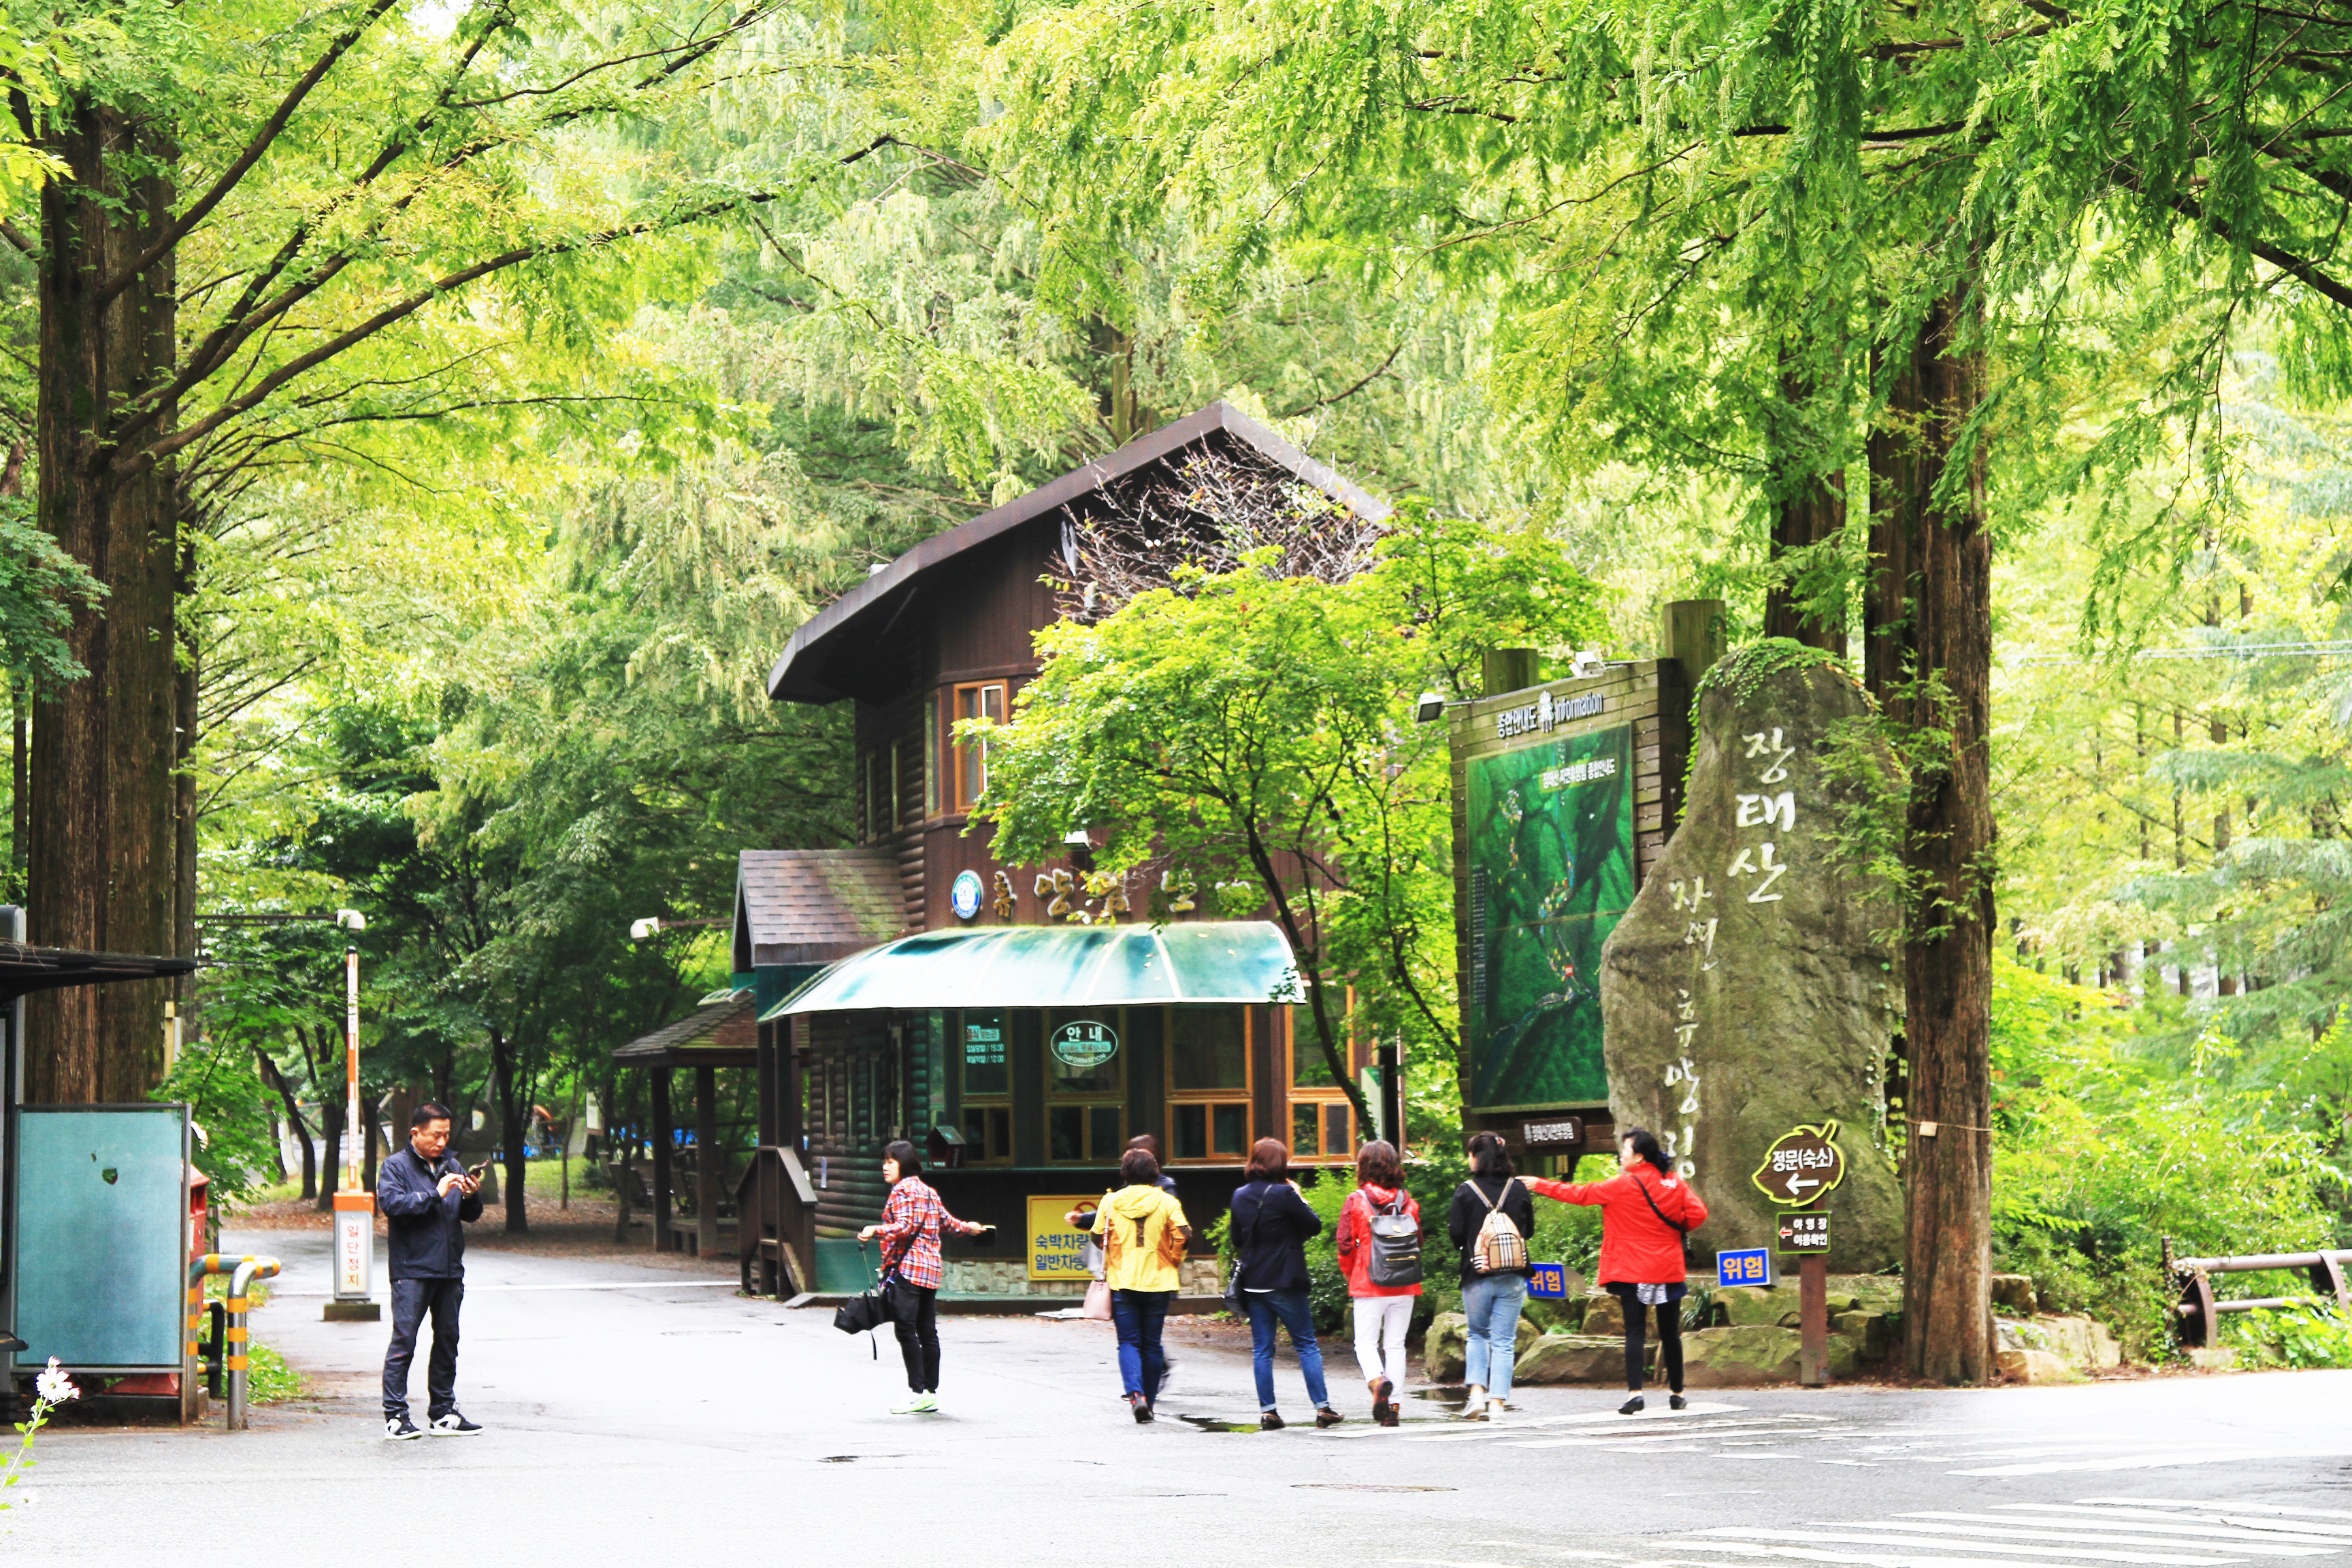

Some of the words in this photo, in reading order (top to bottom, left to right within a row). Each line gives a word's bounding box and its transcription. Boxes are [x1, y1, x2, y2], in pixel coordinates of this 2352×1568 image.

[1497, 705, 1538, 738] 종합안내도
[1062, 1053, 1106, 1064] INFORMATION
[1771, 1147, 1834, 1172] 정문(숙소)
[1793, 1232, 1829, 1247] 이용확인
[346, 1225, 359, 1286] 일단정지
[1722, 1256, 1763, 1279] 위험
